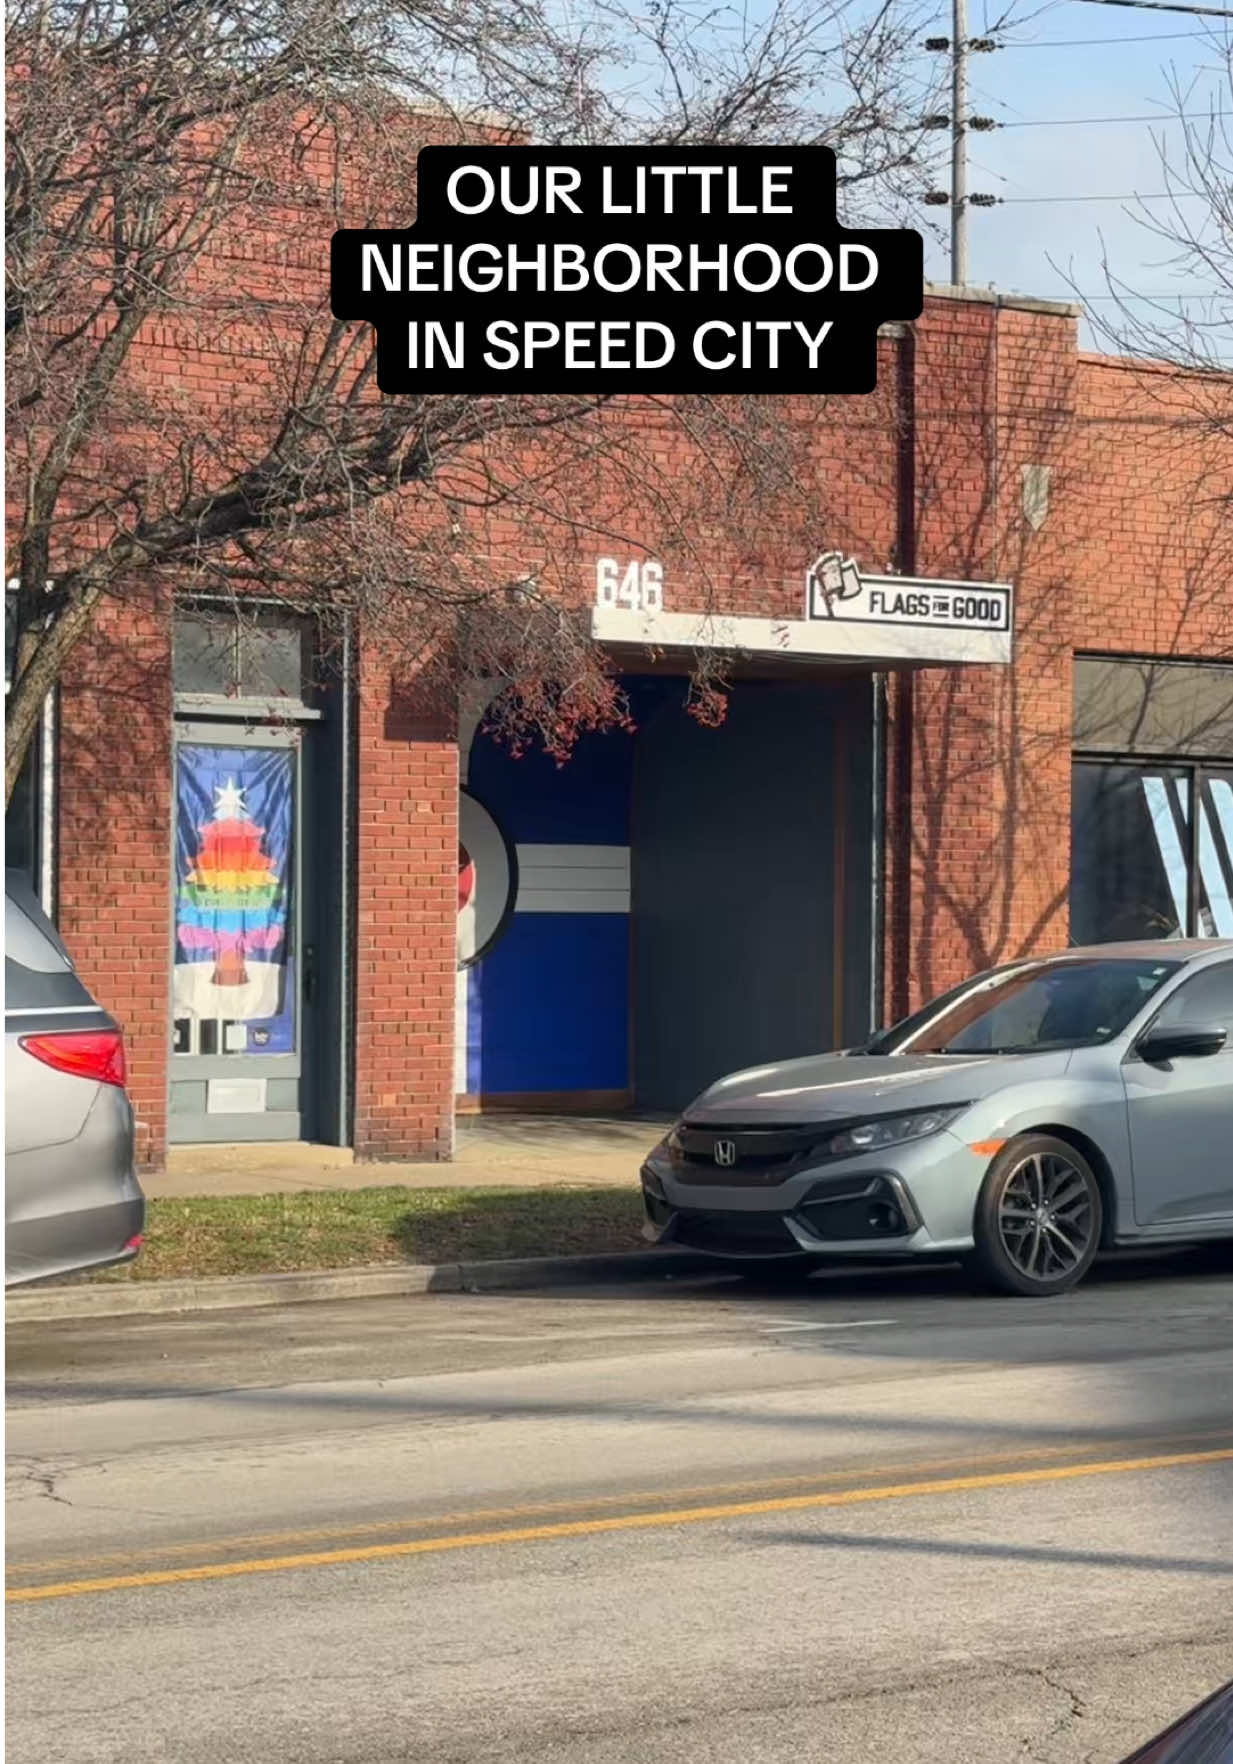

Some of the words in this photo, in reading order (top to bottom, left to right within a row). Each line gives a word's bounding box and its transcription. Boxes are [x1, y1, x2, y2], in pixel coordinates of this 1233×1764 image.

[597, 557, 663, 611] 646
[869, 590, 930, 616] FLAGS
[932, 601, 949, 612] FOR
[953, 596, 1001, 621] GOOD
